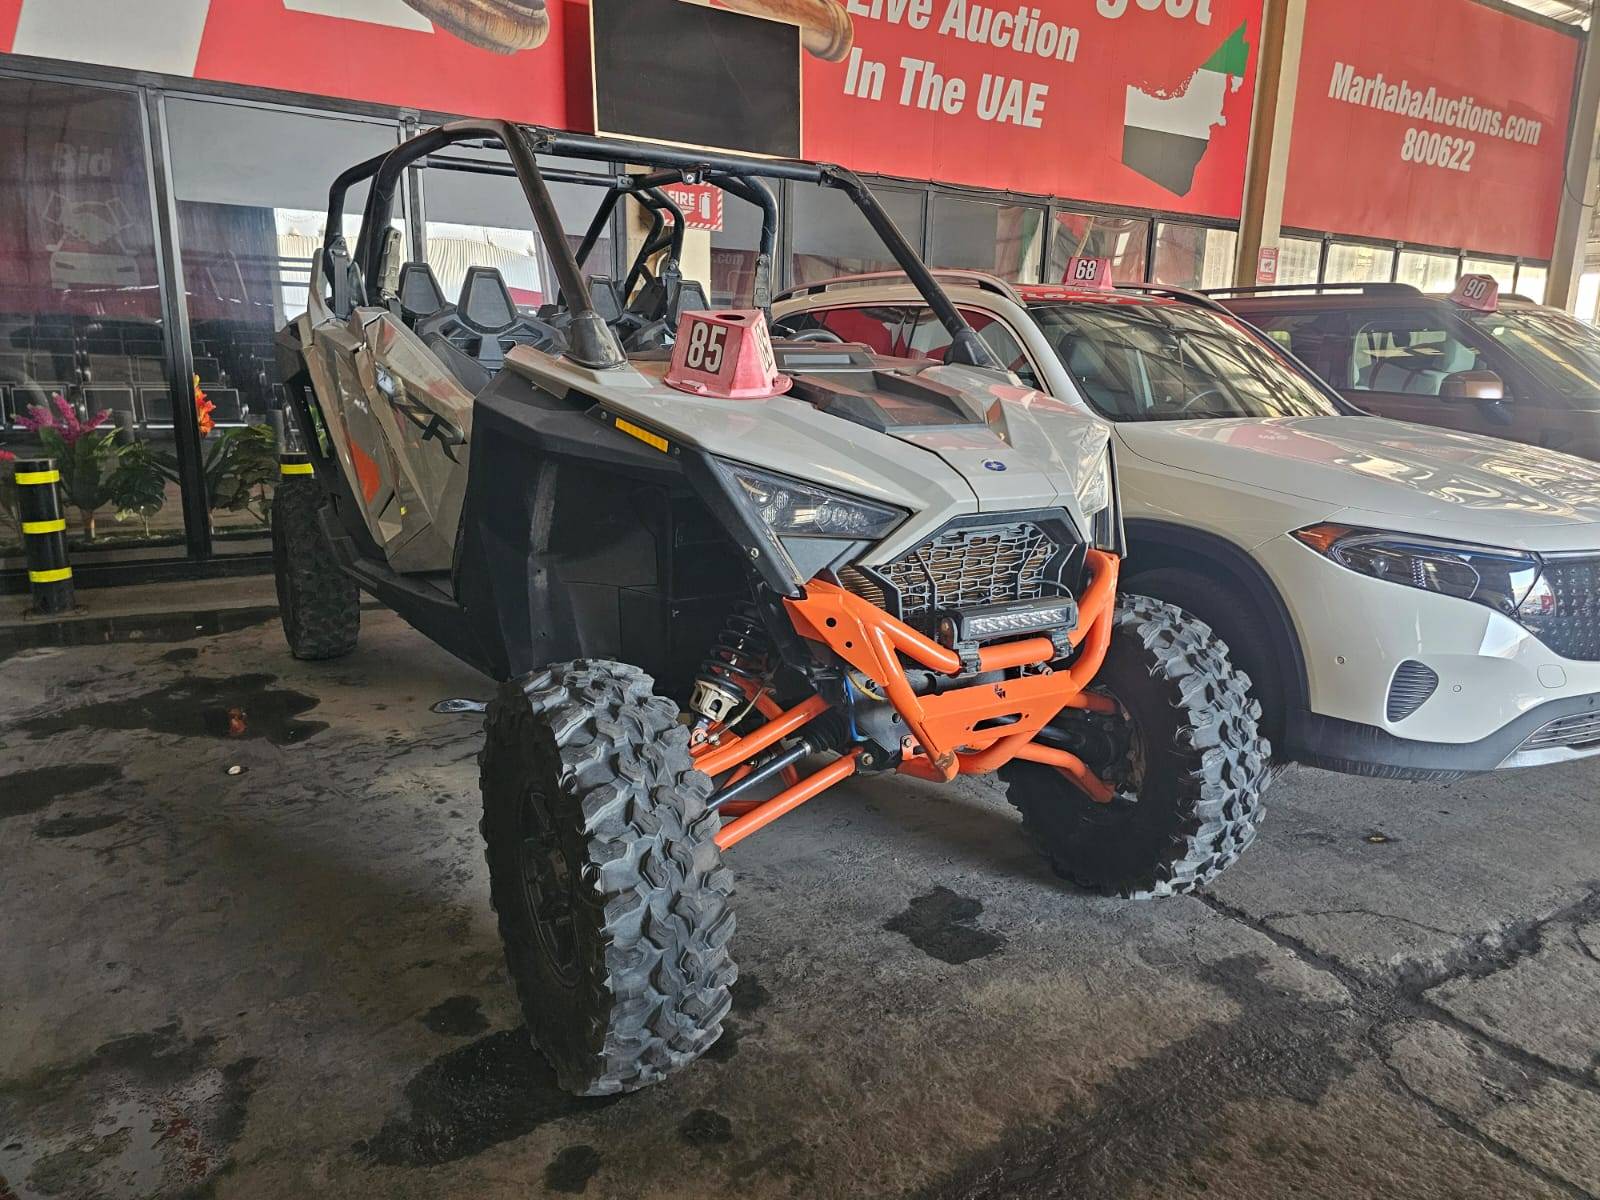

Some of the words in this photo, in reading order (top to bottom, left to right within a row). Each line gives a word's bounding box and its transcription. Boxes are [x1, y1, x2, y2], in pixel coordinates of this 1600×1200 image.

[846, 0, 933, 30] ve
[938, 0, 1080, 62] Auction
[844, 46, 886, 101] In
[898, 56, 967, 115] The
[976, 73, 1049, 129] UAE
[1327, 61, 1542, 146] MarhabaAuctions.com
[1400, 127, 1476, 172] 800622
[668, 190, 696, 206] FIRE
[1075, 259, 1097, 280] 68
[1463, 278, 1488, 299] 90
[687, 322, 728, 374] 85
